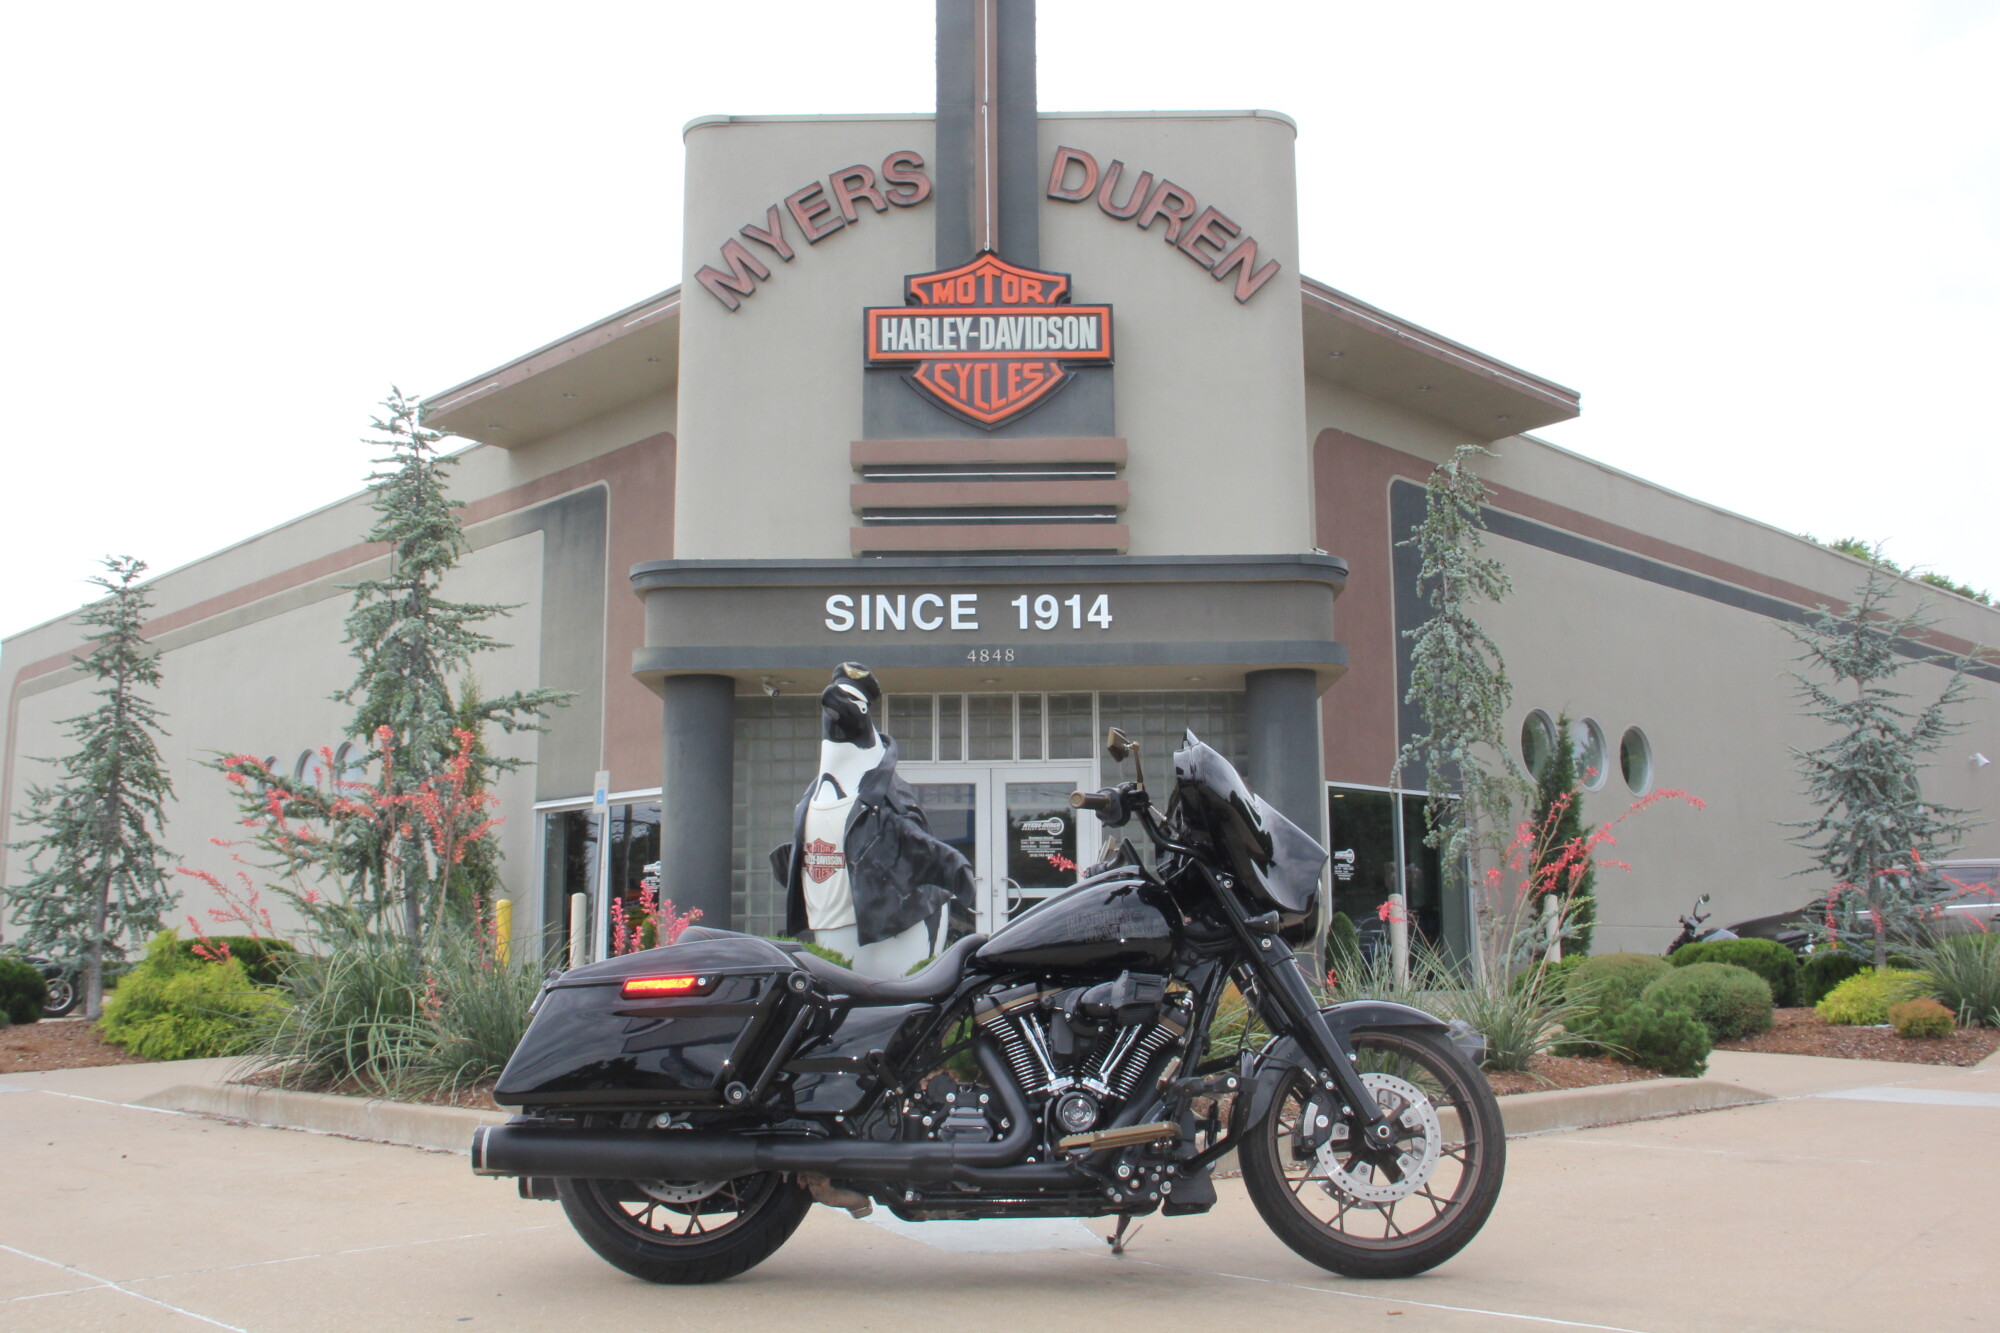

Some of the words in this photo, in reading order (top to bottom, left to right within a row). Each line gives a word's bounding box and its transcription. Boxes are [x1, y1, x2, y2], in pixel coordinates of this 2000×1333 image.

[694, 149, 933, 313] MYERS
[1046, 145, 1282, 305] DUREN
[932, 265, 1046, 304] MOTOR
[880, 314, 1098, 352] HARLEY-DAVIDSON
[933, 361, 1047, 413] CYCLES
[824, 593, 979, 632] SINCE
[1011, 594, 1113, 630] 1914
[967, 648, 1015, 663] 4848
